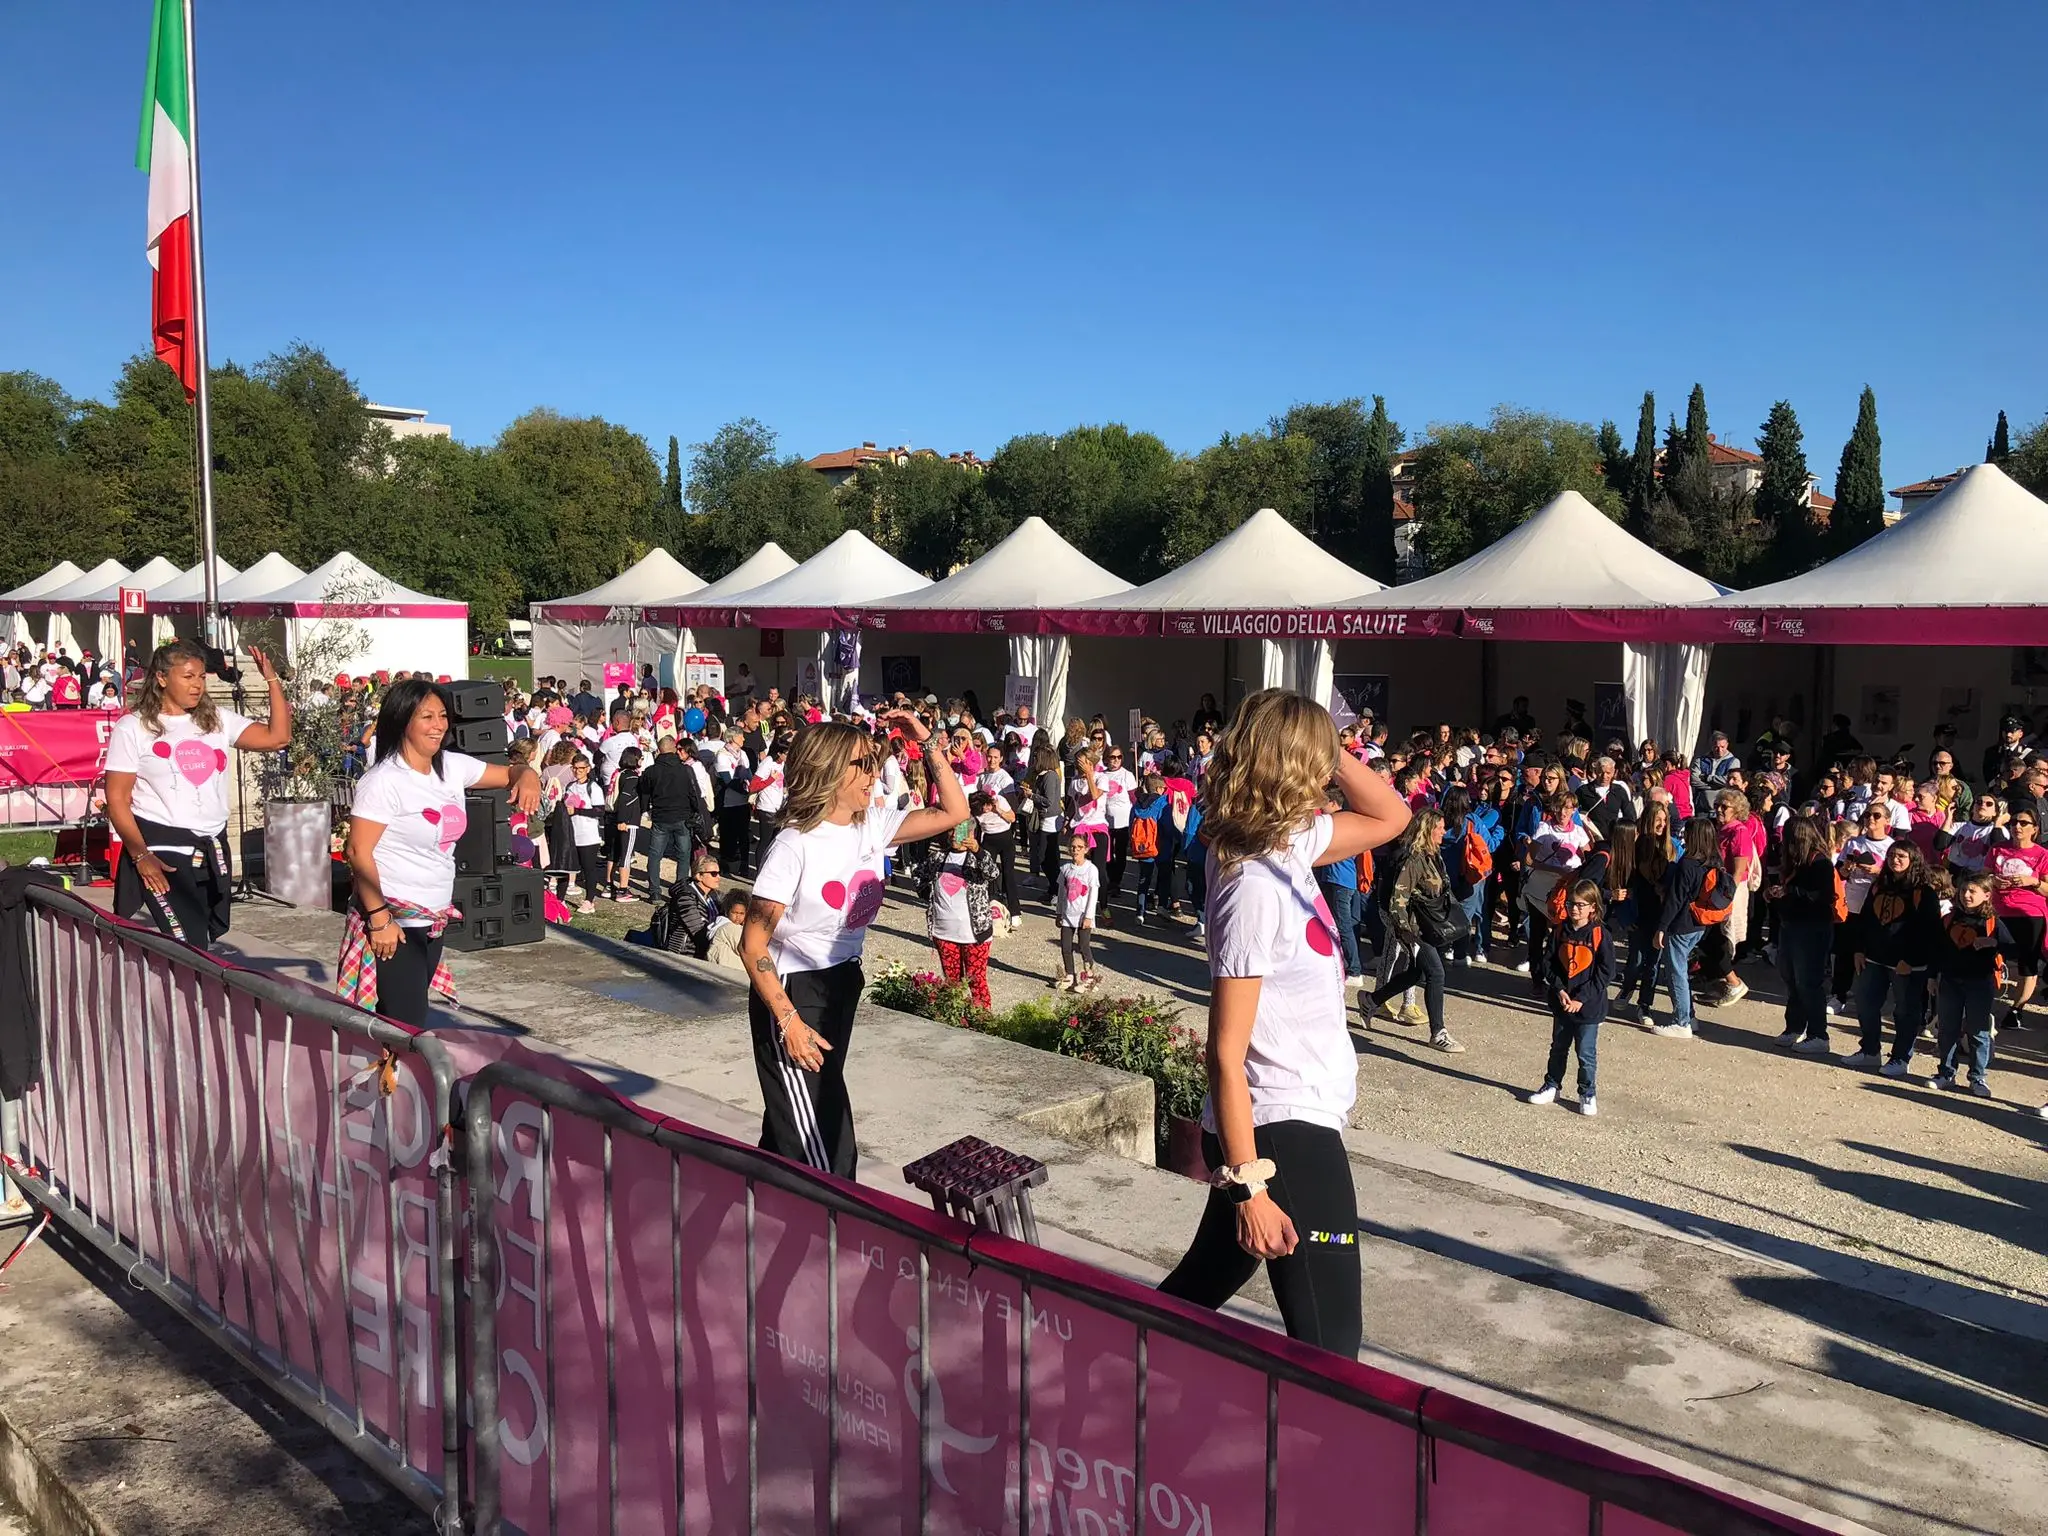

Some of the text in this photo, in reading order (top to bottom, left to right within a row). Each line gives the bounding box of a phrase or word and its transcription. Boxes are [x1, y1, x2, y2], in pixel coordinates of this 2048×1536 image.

[1178, 621, 1195, 629] race
[1203, 614, 1407, 635] VILLAGGIO DELLA SALUTE
[1734, 621, 1754, 629] race
[1781, 621, 1802, 629] race
[182, 761, 207, 771] CURE
[849, 884, 873, 903] RACE
[1309, 1230, 1354, 1245] ZUMBA
